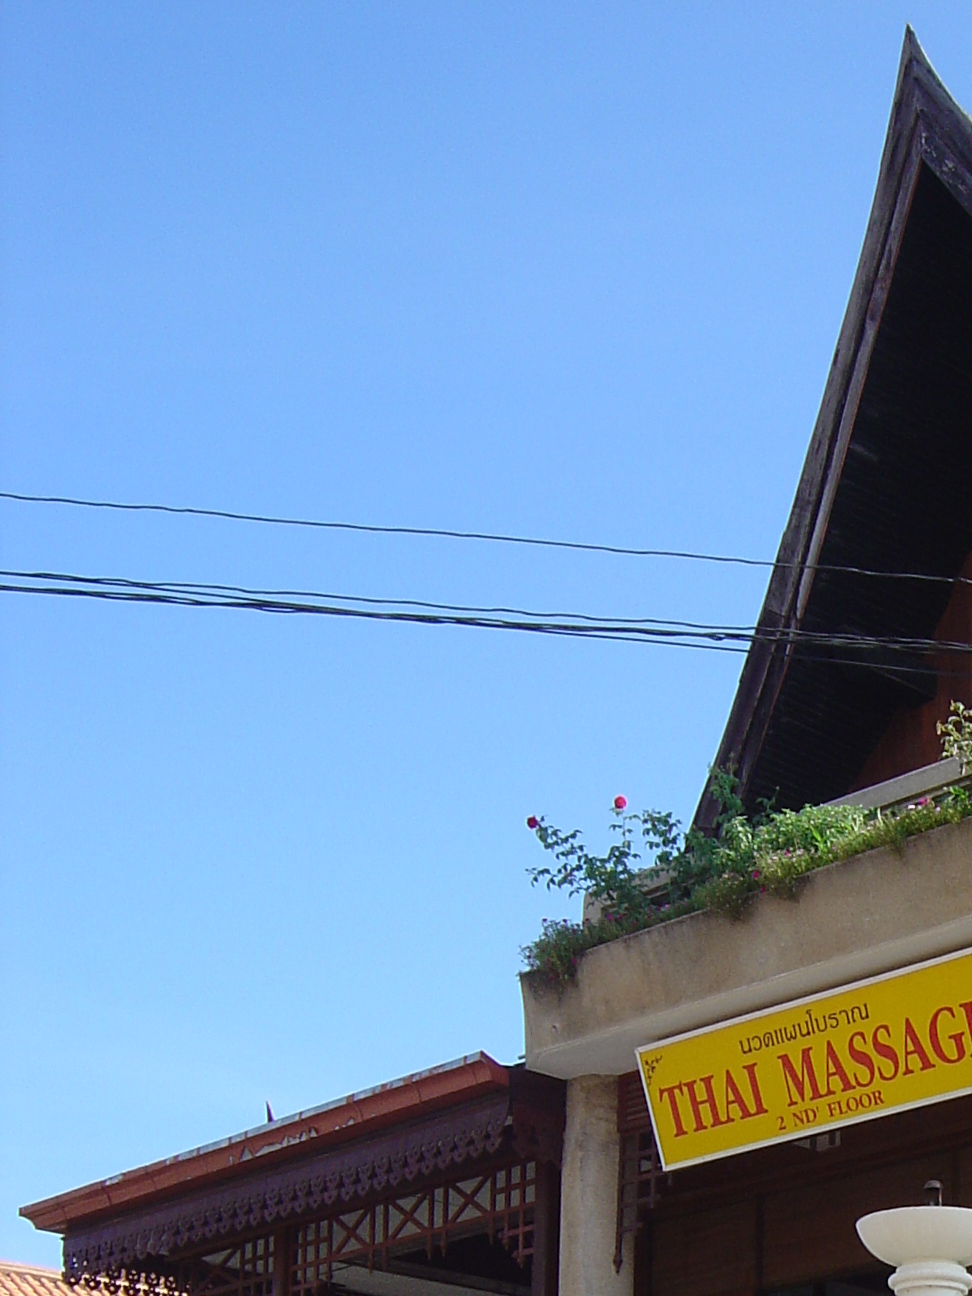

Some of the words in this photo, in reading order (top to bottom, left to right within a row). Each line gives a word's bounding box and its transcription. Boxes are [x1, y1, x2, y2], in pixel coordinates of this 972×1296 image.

[739, 1003, 870, 1054] นวดแผนโบราณ
[659, 1061, 768, 1138] THAI
[776, 1116, 787, 1131] 2
[827, 1090, 885, 1118] FLOOR
